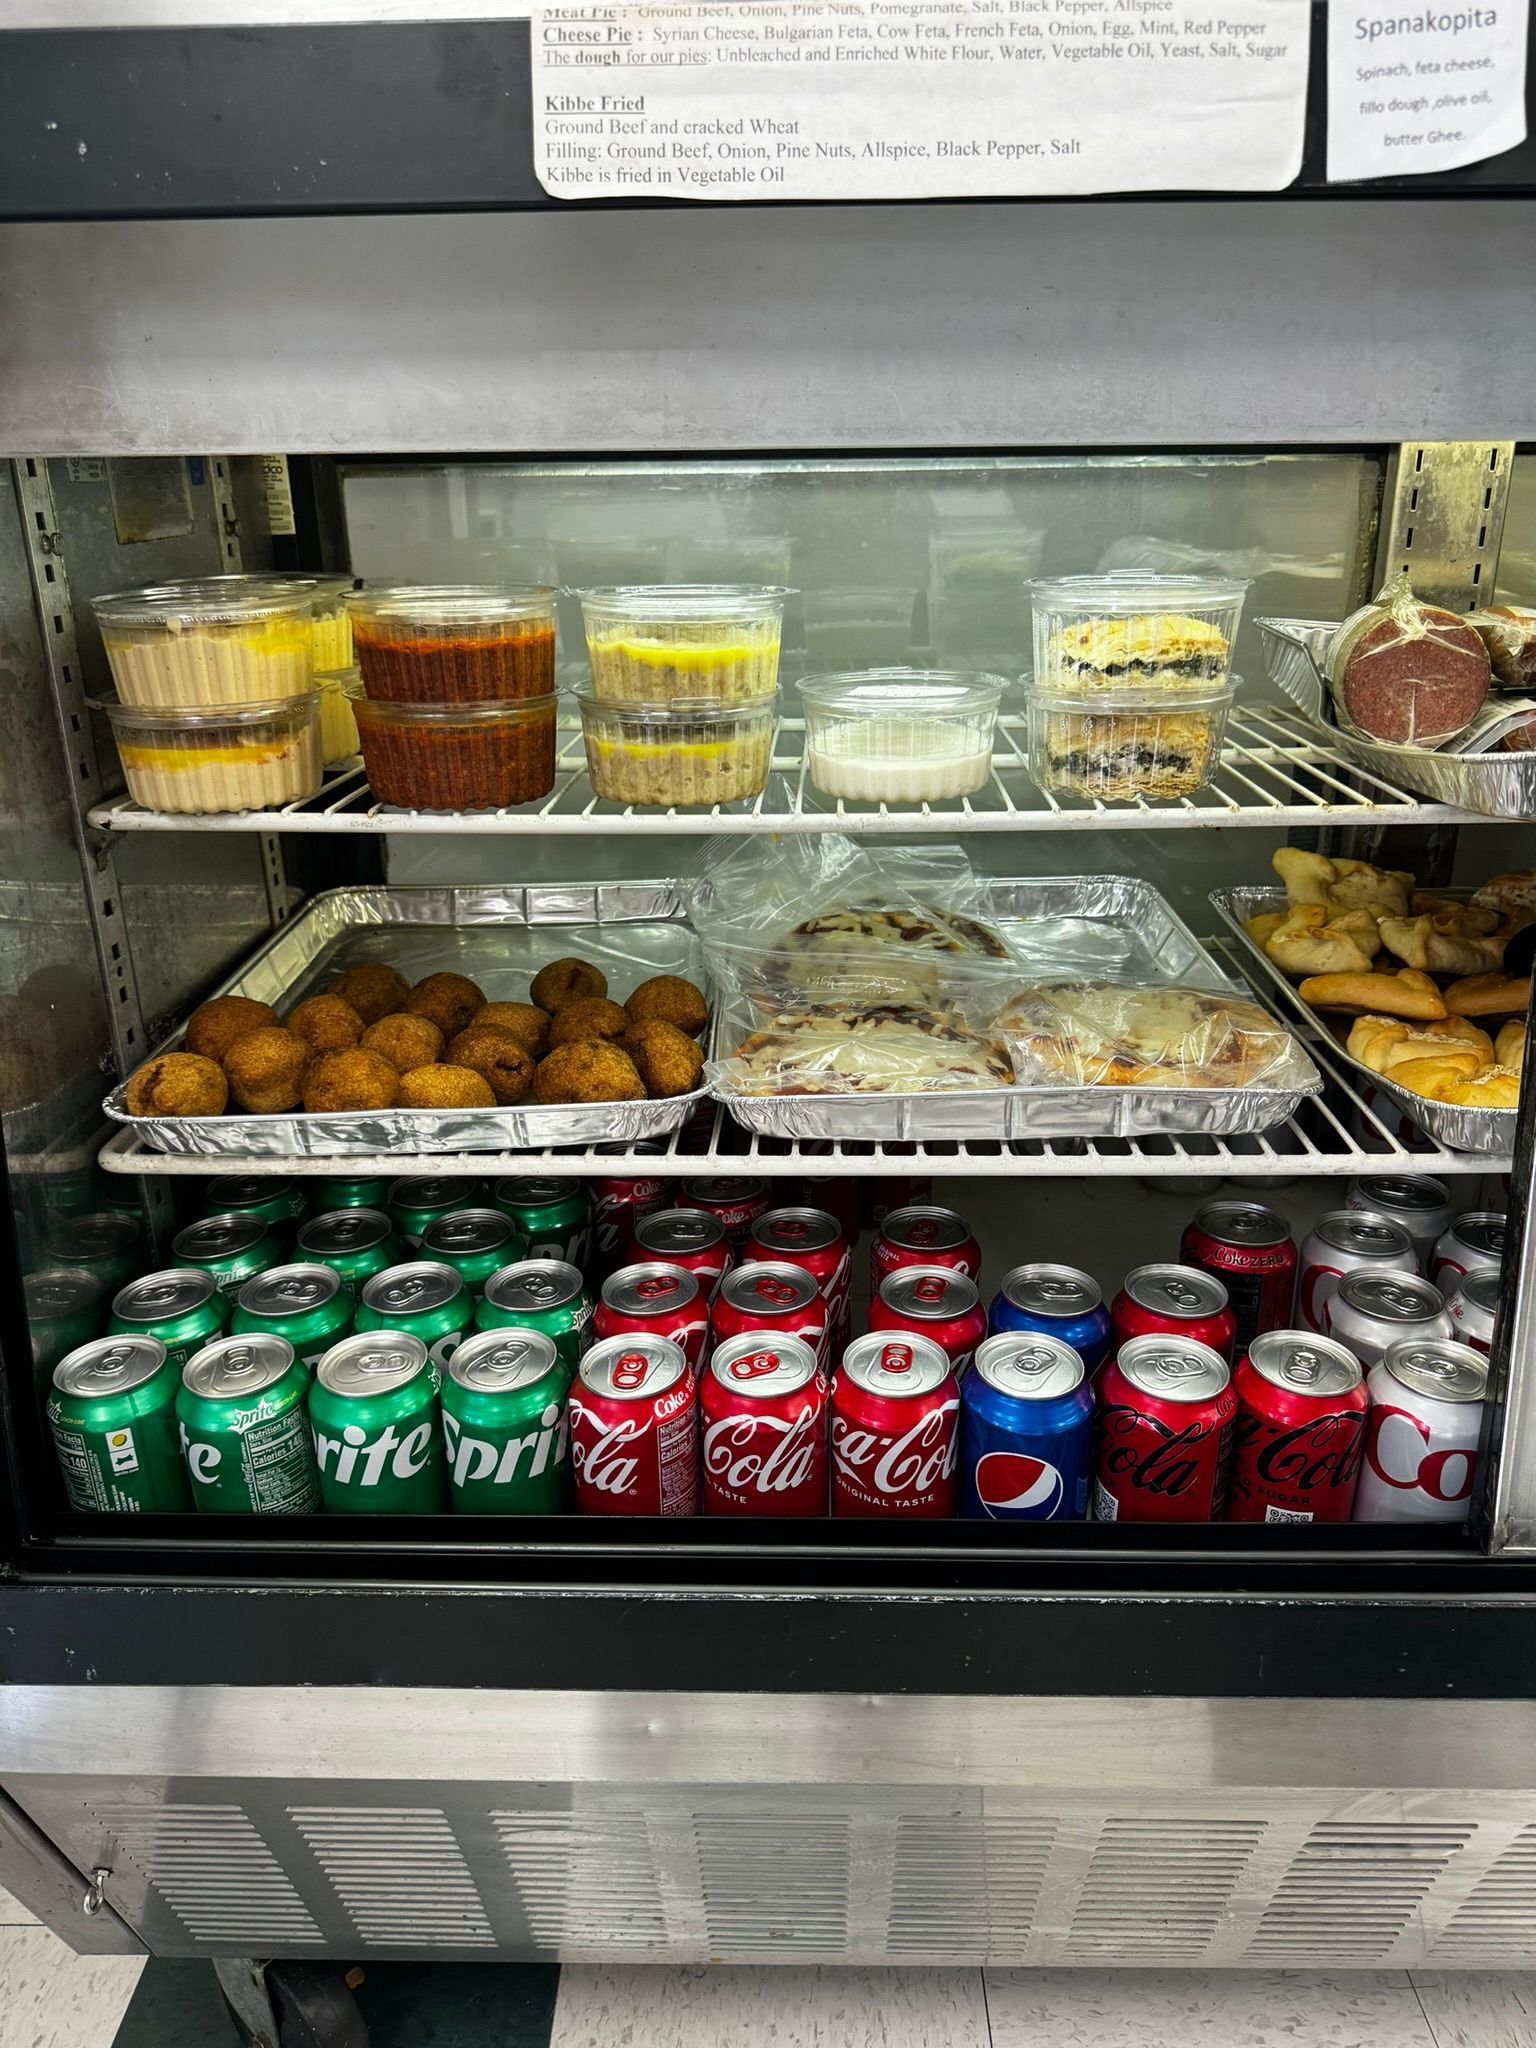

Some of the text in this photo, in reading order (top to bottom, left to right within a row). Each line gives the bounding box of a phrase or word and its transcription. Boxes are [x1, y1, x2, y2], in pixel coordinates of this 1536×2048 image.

[543, 27, 601, 41] Cheese
[606, 27, 632, 41] Pie
[654, 26, 699, 44] Syrian
[704, 26, 758, 42] Cheese,
[765, 25, 833, 43] Bulgarian
[839, 25, 872, 41] Feta,
[877, 24, 910, 38] Cow
[916, 24, 950, 40] Feta,
[956, 24, 1004, 38] French
[1010, 23, 1043, 39] Feta,
[1049, 23, 1097, 39] Onion,
[1103, 22, 1134, 40] Egg,
[1140, 22, 1178, 38] Mint,
[1184, 22, 1212, 35] Red
[1218, 21, 1266, 39] Pepper
[1355, 8, 1497, 42] Spanakopita
[544, 44, 1287, 68] The dough for our pies: Unbleached and Enriched White Flour, Water, Vegetable Oil, Yeast, Salt, Sugar
[1355, 57, 1495, 82] Spinach, feta cheese,
[546, 97, 644, 111] Kibbe Fried
[1359, 101, 1385, 115] fillo
[1388, 97, 1429, 112] dough
[1470, 90, 1493, 104] oil,
[545, 119, 799, 134] Ground Beef and cracked Wheat
[1384, 130, 1466, 147] butter Ghee.
[547, 140, 1080, 162] Filling: Ground Beef, Onion, Pine Nuts, Allspice, Black Pepper, Salt
[547, 168, 784, 186] Kibbe is fried in Vegetable Oil
[654, 1391, 686, 1418] Coke
[232, 1404, 274, 1429] Sprite
[70, 1456, 87, 1469] 140
[252, 1448, 287, 1466] Calories
[311, 1422, 432, 1486] rite
[713, 1481, 748, 1504] TASTE
[836, 1474, 935, 1508] ORIGINAL TASTE
